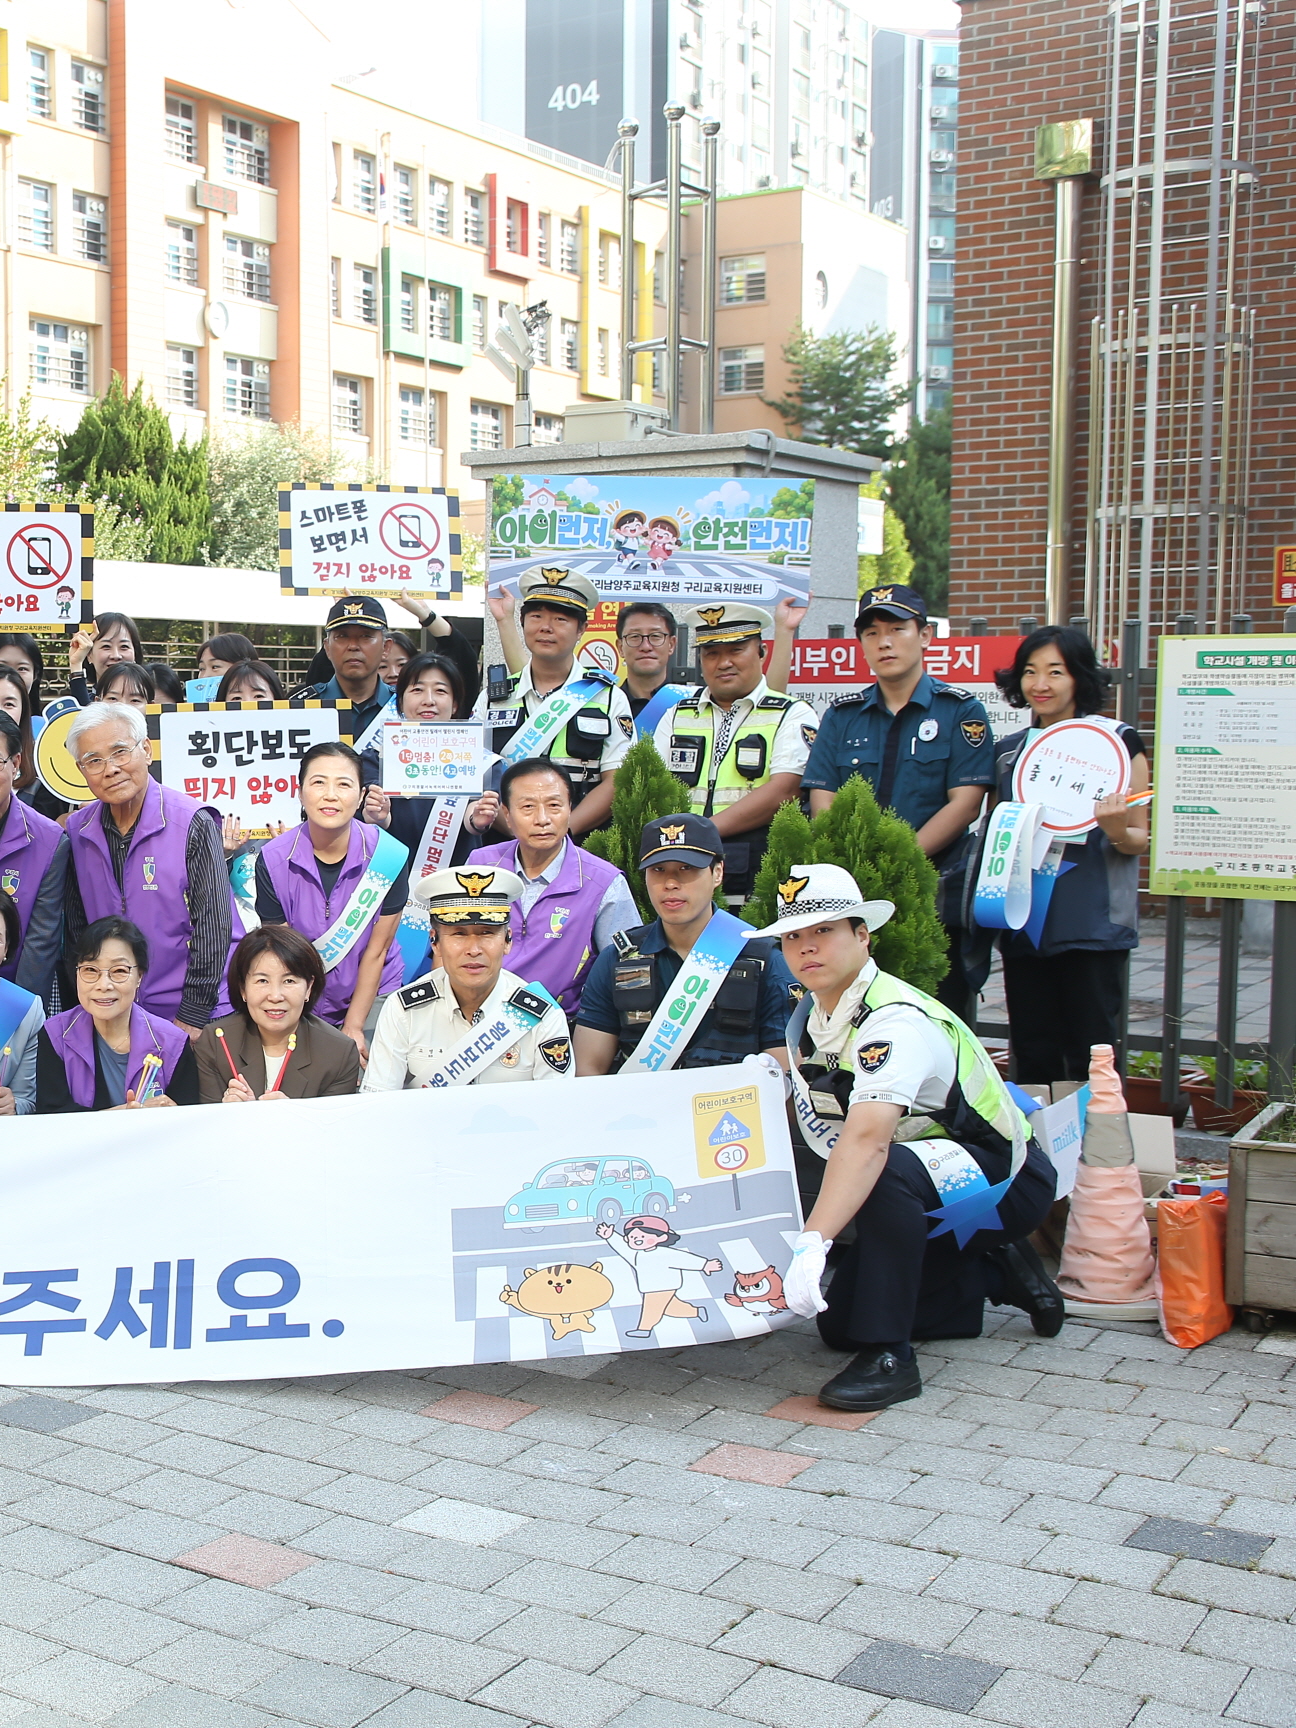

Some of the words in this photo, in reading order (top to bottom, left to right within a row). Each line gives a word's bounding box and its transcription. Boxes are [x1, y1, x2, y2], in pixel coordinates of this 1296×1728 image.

[547, 79, 600, 112] 404
[299, 498, 369, 528] 스마트폰
[310, 526, 370, 554] 보면서
[692, 515, 808, 553] 안전먼저!
[312, 559, 353, 582] 걷지
[358, 560, 413, 582] 않아요
[683, 583, 764, 596] 구리교육지원센터
[1203, 655, 1245, 666] 학교시설
[1247, 655, 1269, 666] 개방
[1271, 655, 1283, 666] 및
[489, 710, 516, 720] 경찰
[188, 728, 312, 769] 횡단보도
[412, 736, 439, 747] 어린이
[440, 736, 477, 748] 보호구역
[672, 750, 695, 763] 경찰
[183, 776, 238, 801] 띄지
[246, 775, 302, 805] 않아
[431, 810, 454, 844] 일단
[317, 887, 377, 963] 아이먼저
[639, 974, 709, 1071] 아이먼저
[443, 1020, 511, 1080] 횡단보도
[697, 1092, 754, 1111] 어린이보호구역
[712, 1131, 747, 1143] 어린이보호
[720, 1148, 743, 1164] 30
[937, 1147, 965, 1163] 구리경찰서
